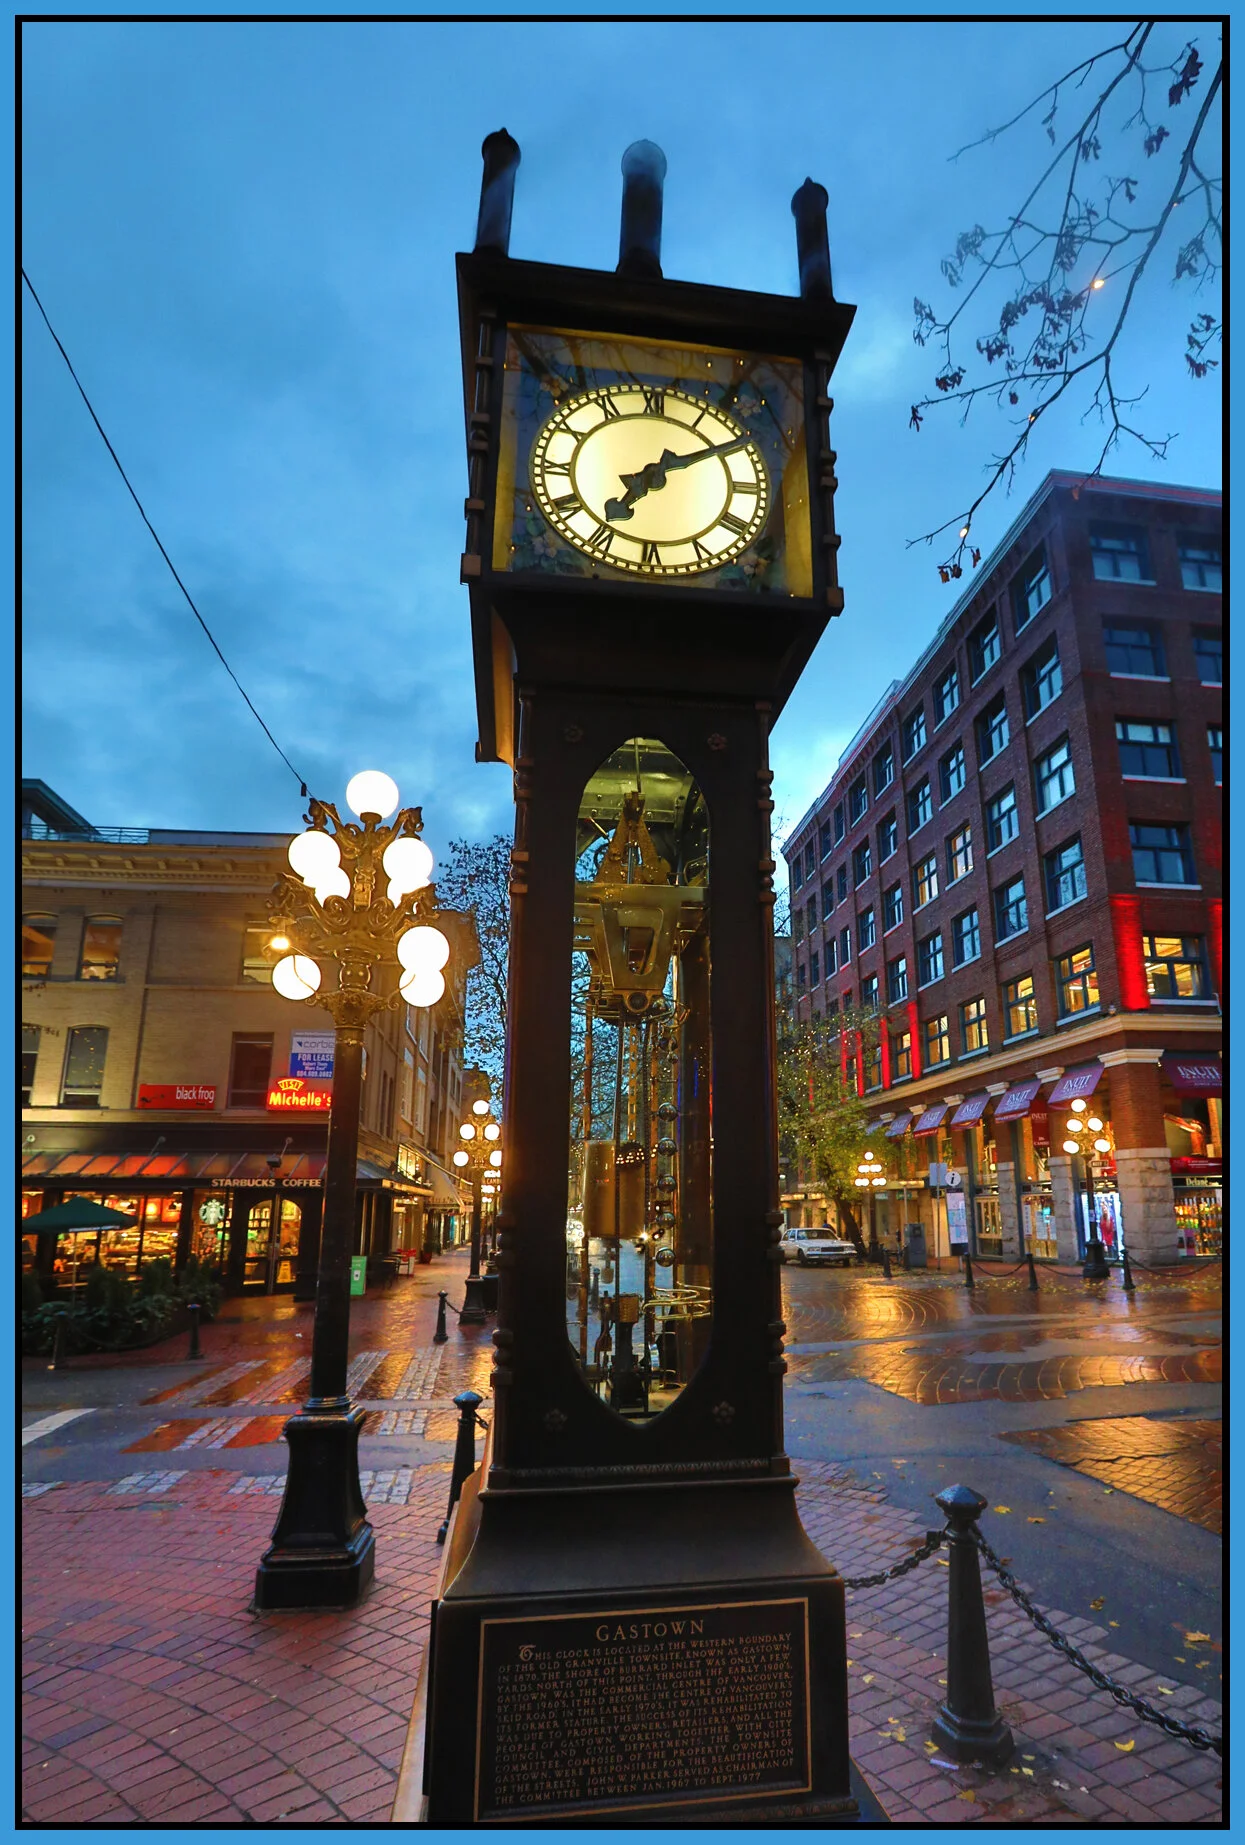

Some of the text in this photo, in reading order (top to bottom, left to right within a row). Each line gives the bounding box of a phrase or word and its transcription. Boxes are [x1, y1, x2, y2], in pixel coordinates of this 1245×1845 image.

[176, 1087, 215, 1103] black frog
[212, 1179, 322, 1187] STARBUCKS COFFEE
[595, 1618, 704, 1641] GASTOWN
[518, 1645, 551, 1661] THIS
[555, 1648, 588, 1658] CLOCK
[605, 1644, 650, 1654] LOCATED
[653, 1643, 664, 1651] AT
[667, 1641, 686, 1650] THE
[689, 1637, 734, 1648] WESTERN
[739, 1633, 791, 1644] BOUNDARY
[498, 1665, 510, 1673] OF
[515, 1663, 534, 1672] THE
[539, 1661, 559, 1670] OLD
[565, 1656, 624, 1668] GRANVILLE
[685, 1649, 723, 1658] KNOWN
[541, 1671, 560, 1679] THE
[565, 1668, 598, 1677] SHORE
[619, 1663, 667, 1673] BURRARD
[671, 1660, 700, 1669] INLET
[705, 1658, 726, 1666] WAS
[730, 1656, 756, 1664] ONLY
[769, 1653, 790, 1661] FEW
[496, 1683, 532, 1693] YARDS
[536, 1680, 572, 1690] NORTH
[576, 1678, 588, 1686] OF
[592, 1676, 615, 1685] THIS
[655, 1669, 701, 1680] THROUGH
[706, 1668, 722, 1676] THE
[728, 1664, 759, 1674] EARLY
[496, 1692, 546, 1703] GASTOWN
[553, 1689, 575, 1698] WAS
[579, 1688, 597, 1696] THE
[602, 1682, 668, 1694] COMMERCIAL
[672, 1678, 711, 1688] CENTRE
[496, 1704, 509, 1713] BY
[513, 1702, 532, 1711] THE
[583, 1697, 604, 1705] HAD
[609, 1693, 648, 1703] BECOME
[652, 1691, 669, 1700] THE
[673, 1688, 710, 1698] CENTRE
[561, 1709, 573, 1717] IN
[577, 1707, 594, 1716] THE
[599, 1704, 631, 1714] EARLY
[680, 1698, 699, 1707] WAS
[703, 1692, 776, 1705] REHABILITATED
[495, 1734, 519, 1743] WAS
[523, 1731, 543, 1740] DUE
[548, 1730, 562, 1738] TO
[566, 1725, 619, 1736] PROPERTY
[730, 1713, 750, 1722] AND
[754, 1711, 771, 1720] ALL
[774, 1710, 792, 1718] THE
[496, 1724, 511, 1732] ITS
[516, 1720, 559, 1731] FORMER
[613, 1714, 632, 1722] THE
[635, 1710, 675, 1720] SUCCESS
[693, 1707, 707, 1715] ITS
[711, 1700, 791, 1714] REHABILITATION
[495, 1719, 792, 1753] PEOPLE OF GASTOWN WORKING TOGETHER WITH CITY
[495, 1751, 544, 1763] COUNCIL
[553, 1748, 576, 1757] AND
[585, 1744, 616, 1754] CIVIC
[710, 1734, 729, 1743] THE
[738, 1728, 792, 1741] TOWNSITE
[554, 1767, 583, 1777] WERE
[590, 1760, 657, 1774] RESPONSIBLE
[663, 1758, 684, 1768] FOR
[688, 1756, 706, 1765] THE
[711, 1748, 793, 1763] BEAUTIFICATION
[567, 1754, 623, 1766] COMPOSED
[629, 1752, 641, 1760] OF
[647, 1750, 666, 1759] THE
[673, 1744, 726, 1756] PROPERTY
[732, 1740, 776, 1751] OWNERS
[780, 1739, 792, 1747] OF
[494, 1785, 507, 1794] OF
[511, 1783, 530, 1792] THE
[586, 1775, 614, 1785] JOHN
[630, 1770, 670, 1781] PARKER
[673, 1766, 710, 1777] SERVED
[712, 1764, 723, 1773] AS
[725, 1759, 779, 1772] CHAIRMAN
[781, 1758, 793, 1766] OF
[495, 1795, 513, 1804] THE
[519, 1789, 580, 1802] COMMITTEE
[587, 1783, 636, 1796] BETWEEN
[666, 1778, 689, 1788] 1967
[694, 1777, 706, 1785] TO
